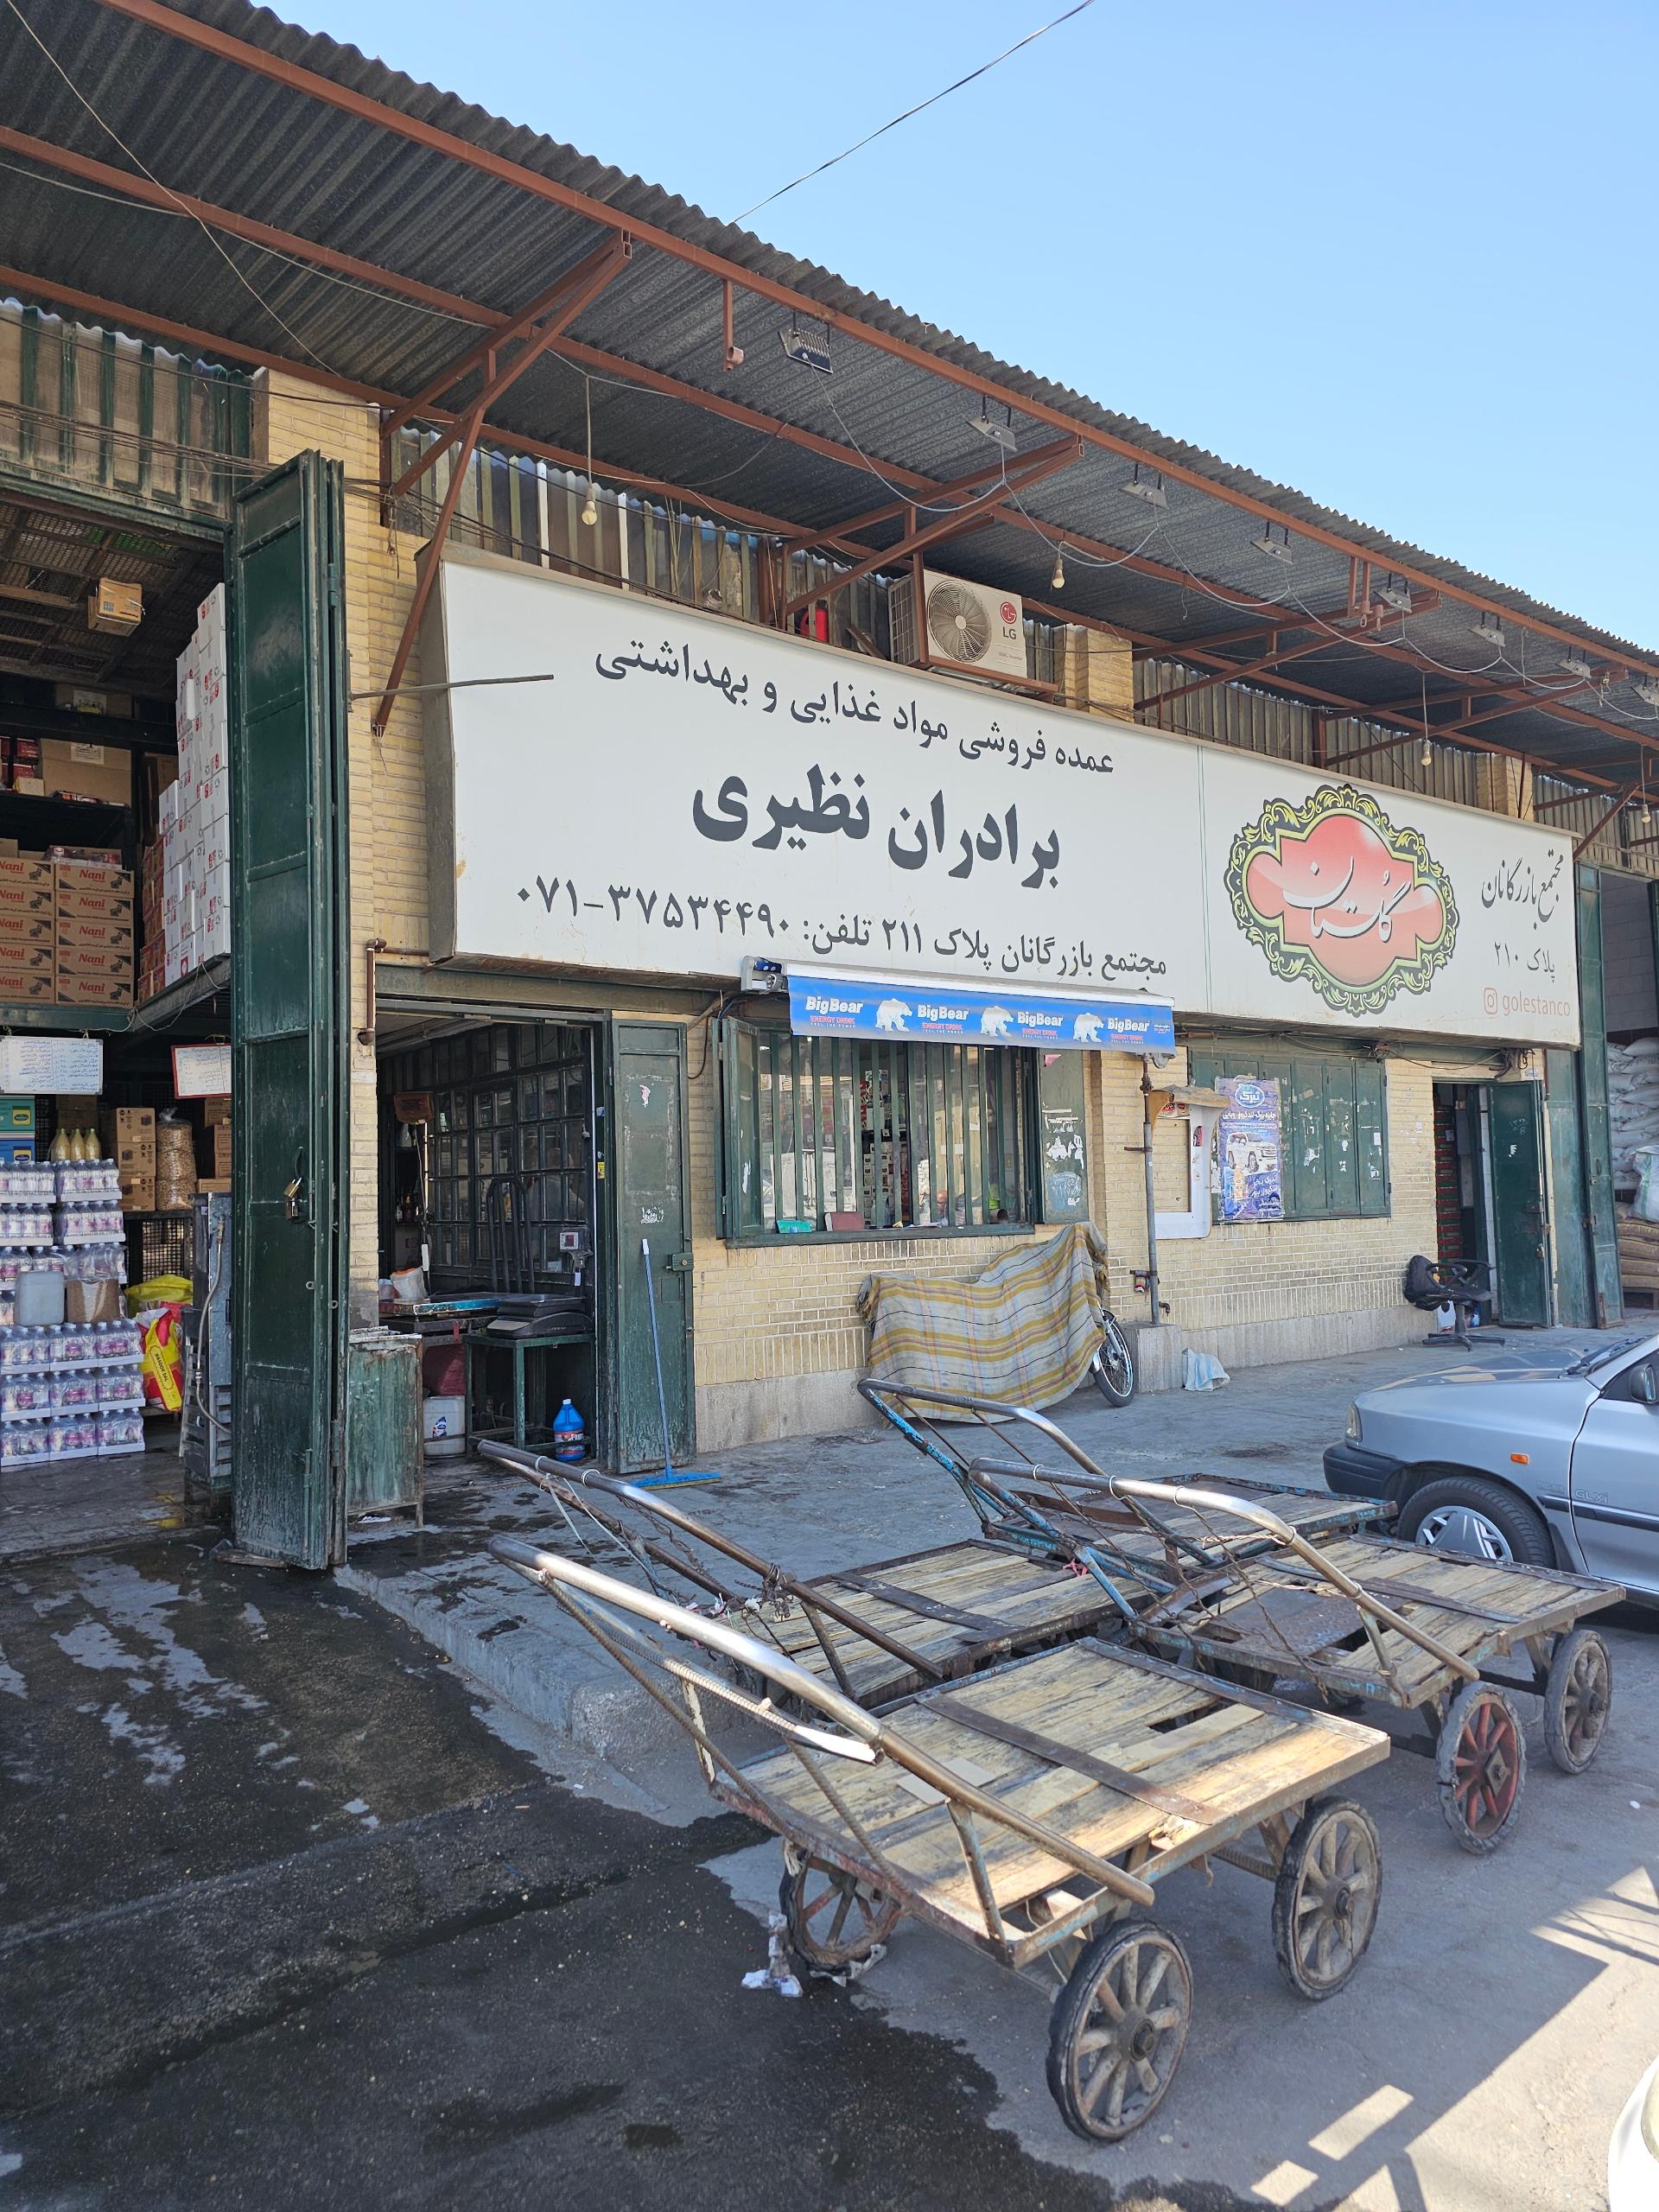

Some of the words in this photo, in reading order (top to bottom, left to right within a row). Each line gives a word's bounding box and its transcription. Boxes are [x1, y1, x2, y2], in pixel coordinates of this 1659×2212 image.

[1002, 626, 1017, 639] LG
[596, 640, 748, 707] بهداشتی
[762, 682, 778, 714] و
[790, 681, 881, 724] غذایی
[893, 701, 948, 749] مواد
[959, 721, 1046, 770] فروشی
[1055, 747, 1114, 773] عمده
[692, 763, 870, 851] نظیری
[887, 790, 1060, 889] برادران
[79, 868, 105, 880] Nani
[1537, 849, 1564, 923] مجتمع
[79, 897, 105, 907] Nani
[1481, 856, 1537, 931] بازرگانان
[79, 925, 105, 936] Nani
[804, 913, 873, 955] تلفن:
[881, 919, 922, 953] ۲۱۱
[79, 953, 105, 964] Nani
[934, 928, 992, 970] پلاک
[1002, 935, 1092, 977] بازرگانان
[1494, 939, 1518, 968] ۲۱۰
[1101, 955, 1166, 982] مجتمع
[1527, 947, 1555, 983] پلاک
[79, 982, 105, 991] Nani
[805, 995, 864, 1015] BigBear
[917, 1004, 969, 1022] BigBear
[1502, 990, 1571, 1016] golestanco
[1017, 1011, 1064, 1027] BigBear
[1107, 1017, 1150, 1033] BigBear
[155, 1353, 165, 1372] MASOOR
[1575, 1489, 1610, 1503] GLXi
